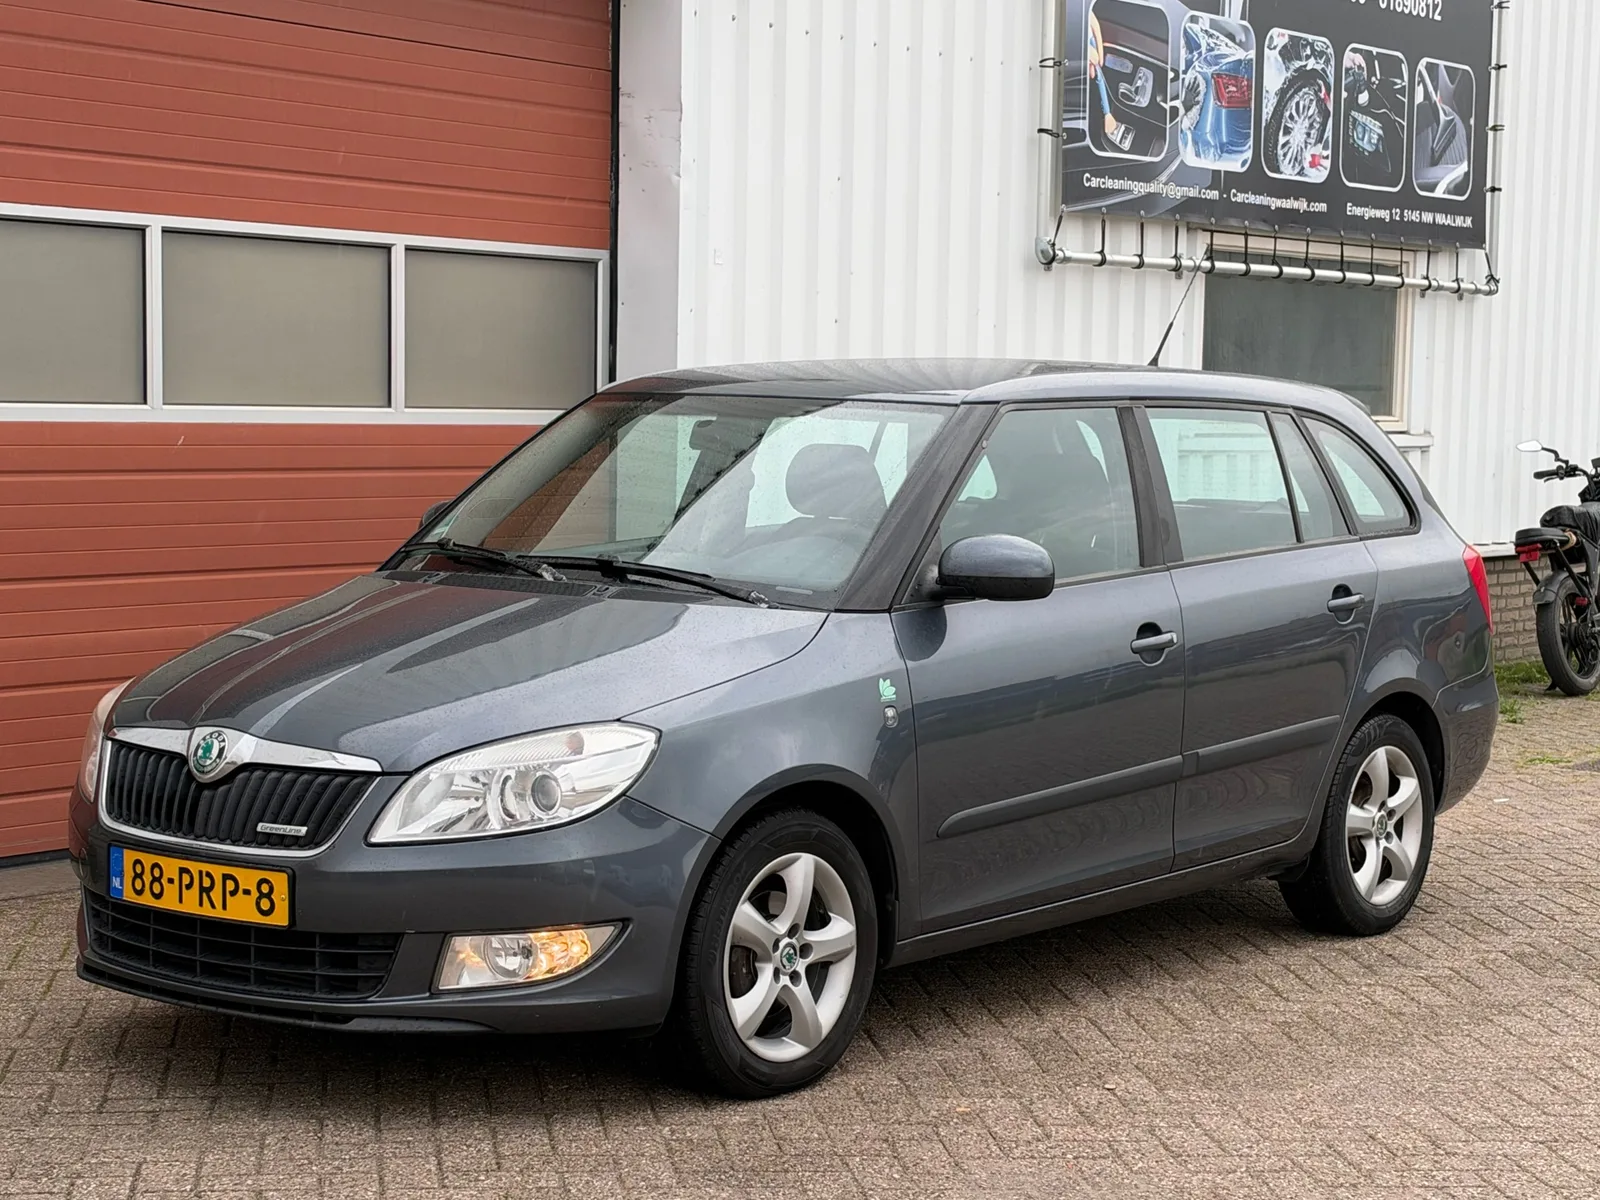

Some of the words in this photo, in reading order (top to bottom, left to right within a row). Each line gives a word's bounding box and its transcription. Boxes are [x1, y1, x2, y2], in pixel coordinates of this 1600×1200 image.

[1083, 172, 1219, 200] Carcleaningquality@gmail.com
[1230, 188, 1327, 213] Carcleaningwaalwijk.com
[1346, 202, 1390, 222] Energieweg
[1392, 208, 1400, 220] 12
[1403, 209, 1420, 222] 5145
[1421, 211, 1434, 224] NW
[1435, 212, 1473, 228] WAALWIJK
[112, 876, 123, 889] NL
[131, 858, 276, 917] 88-PRP-8
